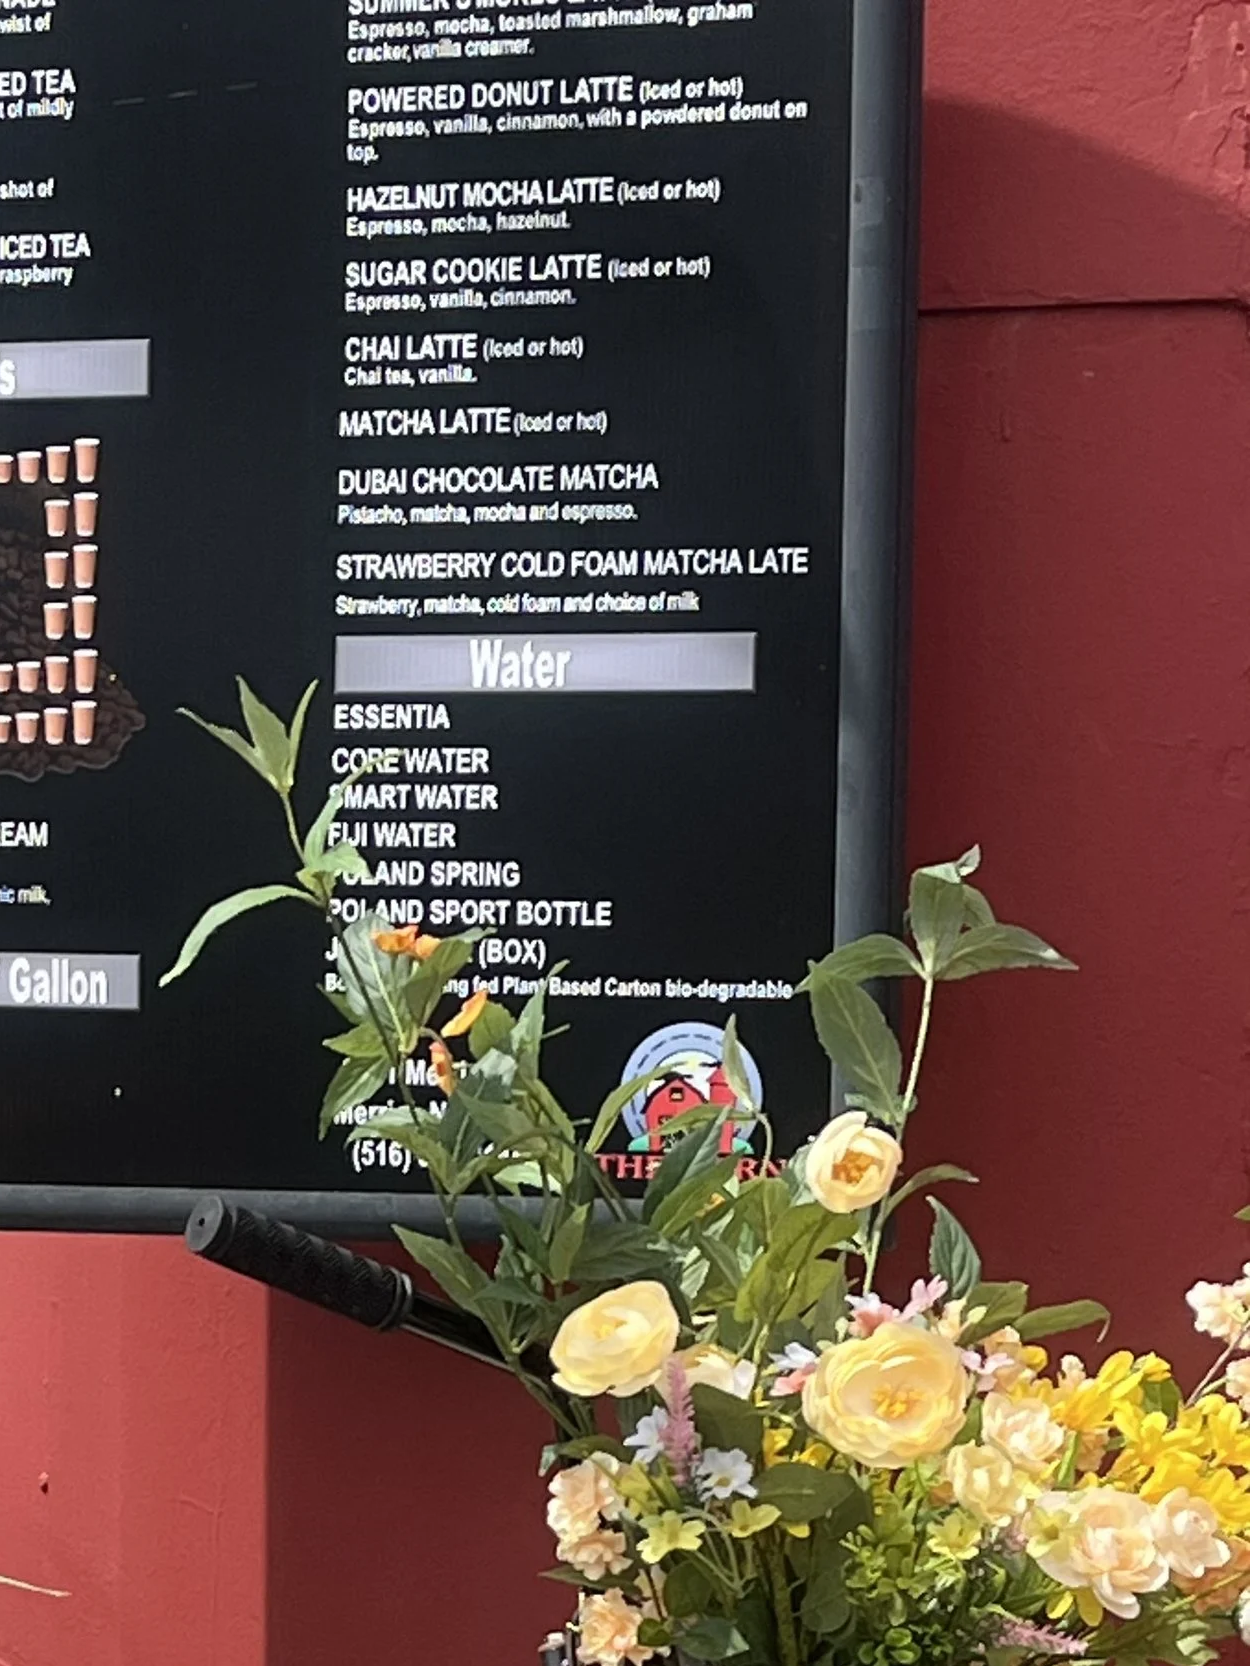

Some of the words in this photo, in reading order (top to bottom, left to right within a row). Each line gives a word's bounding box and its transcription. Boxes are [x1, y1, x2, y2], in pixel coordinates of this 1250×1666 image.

[34, 13, 50, 31] of
[498, 11, 560, 31] toasted
[687, 4, 752, 26] graham
[31, 69, 75, 94] TEA
[348, 84, 464, 113] POWERED
[471, 81, 553, 107] DONUT
[560, 78, 632, 103] LATTE
[639, 79, 681, 104] (Iced
[685, 81, 704, 103] or
[708, 76, 742, 102] hot)
[7, 100, 23, 118] of
[586, 108, 621, 127] with
[626, 110, 636, 125] a
[641, 104, 724, 129] powdered
[729, 102, 779, 120] donut
[784, 101, 807, 118] on
[0, 180, 33, 199] shot
[37, 178, 53, 197] of
[347, 185, 458, 212] HAZELNUT
[462, 182, 543, 207] MOCHA
[547, 180, 613, 204] LATTE
[617, 180, 658, 205] (Iced
[663, 183, 682, 199] or
[685, 178, 720, 202] hot)
[0, 234, 46, 259] ICED
[49, 233, 90, 257] TEA
[0, 266, 73, 286] raspberry
[345, 260, 426, 287] SUGAR
[432, 258, 522, 284] COOKIE
[529, 256, 601, 280] LATTE
[608, 257, 649, 281] (Iced
[653, 261, 672, 276] or
[676, 256, 709, 278] hot)
[344, 335, 399, 361] CHAI
[406, 334, 477, 359] LATTE
[483, 337, 523, 361] (Iced
[527, 341, 546, 355] or
[549, 336, 582, 358] hot)
[344, 366, 381, 385] Chai
[339, 409, 435, 436] MATCHA
[439, 408, 510, 433] LATTE
[513, 411, 552, 435] (Iced
[556, 415, 573, 431] or
[576, 411, 606, 434] hot)
[338, 468, 406, 494] DUBAI
[412, 465, 553, 493] CHOCOLATE
[560, 463, 658, 490] MATCHA
[336, 552, 496, 579] STRAWBERRY
[501, 551, 564, 577] COLD
[571, 550, 637, 576] FOAM
[643, 548, 742, 575] MATCHA
[749, 547, 808, 573] LATE
[470, 639, 570, 687] Water
[334, 704, 449, 729] ESSENTIA
[331, 748, 400, 773] CORE
[404, 747, 490, 773] WATER
[328, 784, 411, 810] SMART
[414, 784, 497, 809] WATER
[327, 822, 367, 847] FIJI
[373, 822, 455, 847] WATER
[430, 861, 519, 886] SPRING
[429, 899, 510, 924] SPORT
[516, 900, 611, 925] BOTTLE
[479, 938, 546, 969] (BOX)
[10, 958, 105, 1003] Gallon
[549, 976, 600, 997] Based
[604, 977, 661, 996] Carton
[665, 978, 792, 1001] bio-degradable
